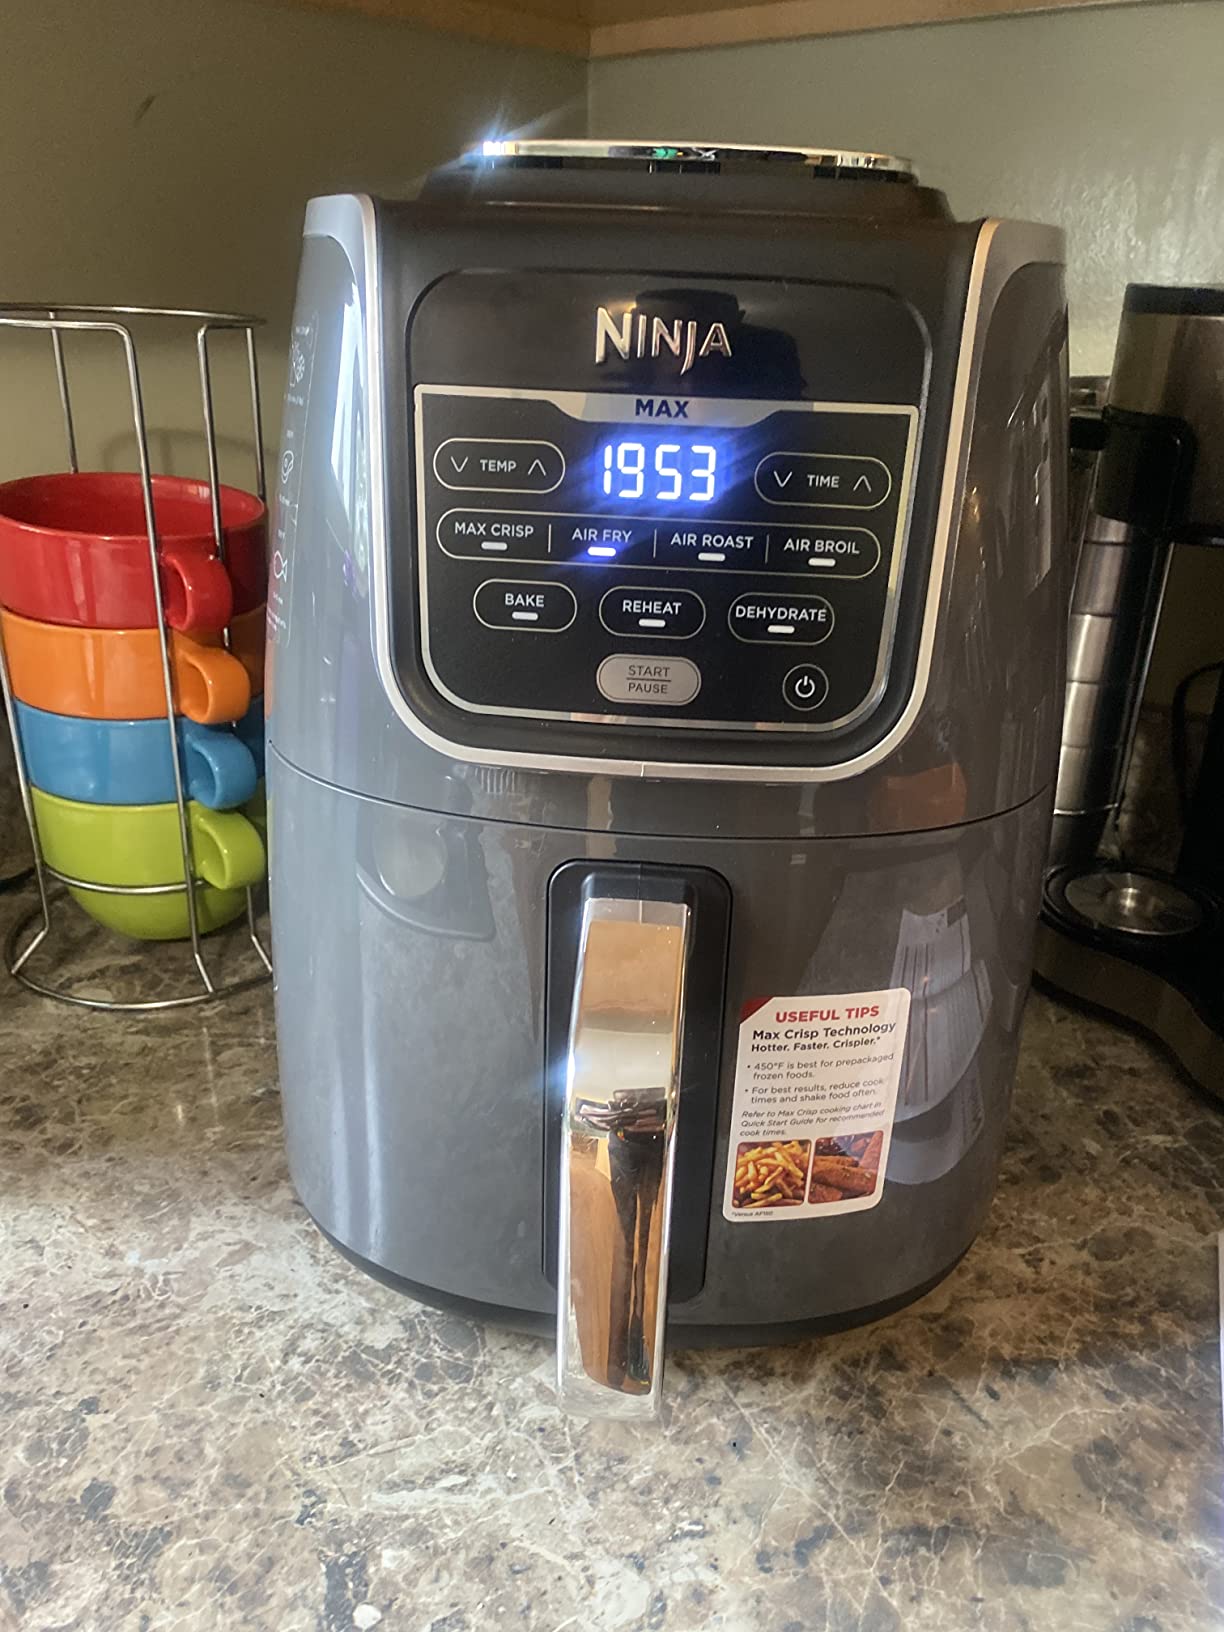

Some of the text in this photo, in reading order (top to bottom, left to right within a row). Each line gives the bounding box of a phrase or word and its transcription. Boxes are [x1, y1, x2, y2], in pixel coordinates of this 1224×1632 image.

[596, 306, 732, 376] NINJA
[635, 398, 689, 418] MAX
[480, 459, 517, 472] TEMP
[603, 442, 717, 501] 1953
[807, 474, 840, 488] TIME
[454, 522, 534, 537] MAX CRISP
[572, 528, 632, 542] AIR FRY
[670, 532, 754, 549] AIR ROAST
[784, 538, 860, 554] AIR BROIL
[505, 593, 545, 608] BAKE
[622, 600, 682, 616] REHEAT
[735, 605, 828, 622] DEHYDRATE
[628, 665, 671, 678] START
[628, 681, 668, 695] PAUSE
[775, 1005, 880, 1023] USEFUL TIPS
[752, 1022, 897, 1041] Max Crisp Technology
[751, 1043, 790, 1052] Hotter.
[793, 1041, 830, 1051] Faster.
[787, 1061, 795, 1070] is
[797, 1060, 817, 1069] best
[820, 1058, 834, 1068] for
[836, 1053, 894, 1068] prepackaged
[752, 1070, 815, 1081] frozen foods.
[751, 1086, 769, 1096] For
[770, 1085, 792, 1095] best
[794, 1084, 827, 1094] results,
[829, 1080, 861, 1091] reduce
[751, 1095, 778, 1104] times
[779, 1094, 798, 1104] and
[800, 1092, 827, 1102] shake
[828, 1090, 850, 1100] food
[741, 1110, 765, 1119] Refer
[767, 1110, 776, 1118] to
[777, 1109, 795, 1118] Max
[797, 1107, 818, 1118] Crisp
[820, 1104, 851, 1115] cooking
[853, 1102, 873, 1112] chart
[741, 1109, 885, 1129] Quick Start Guide for recommended
[740, 1129, 760, 1137] cook
